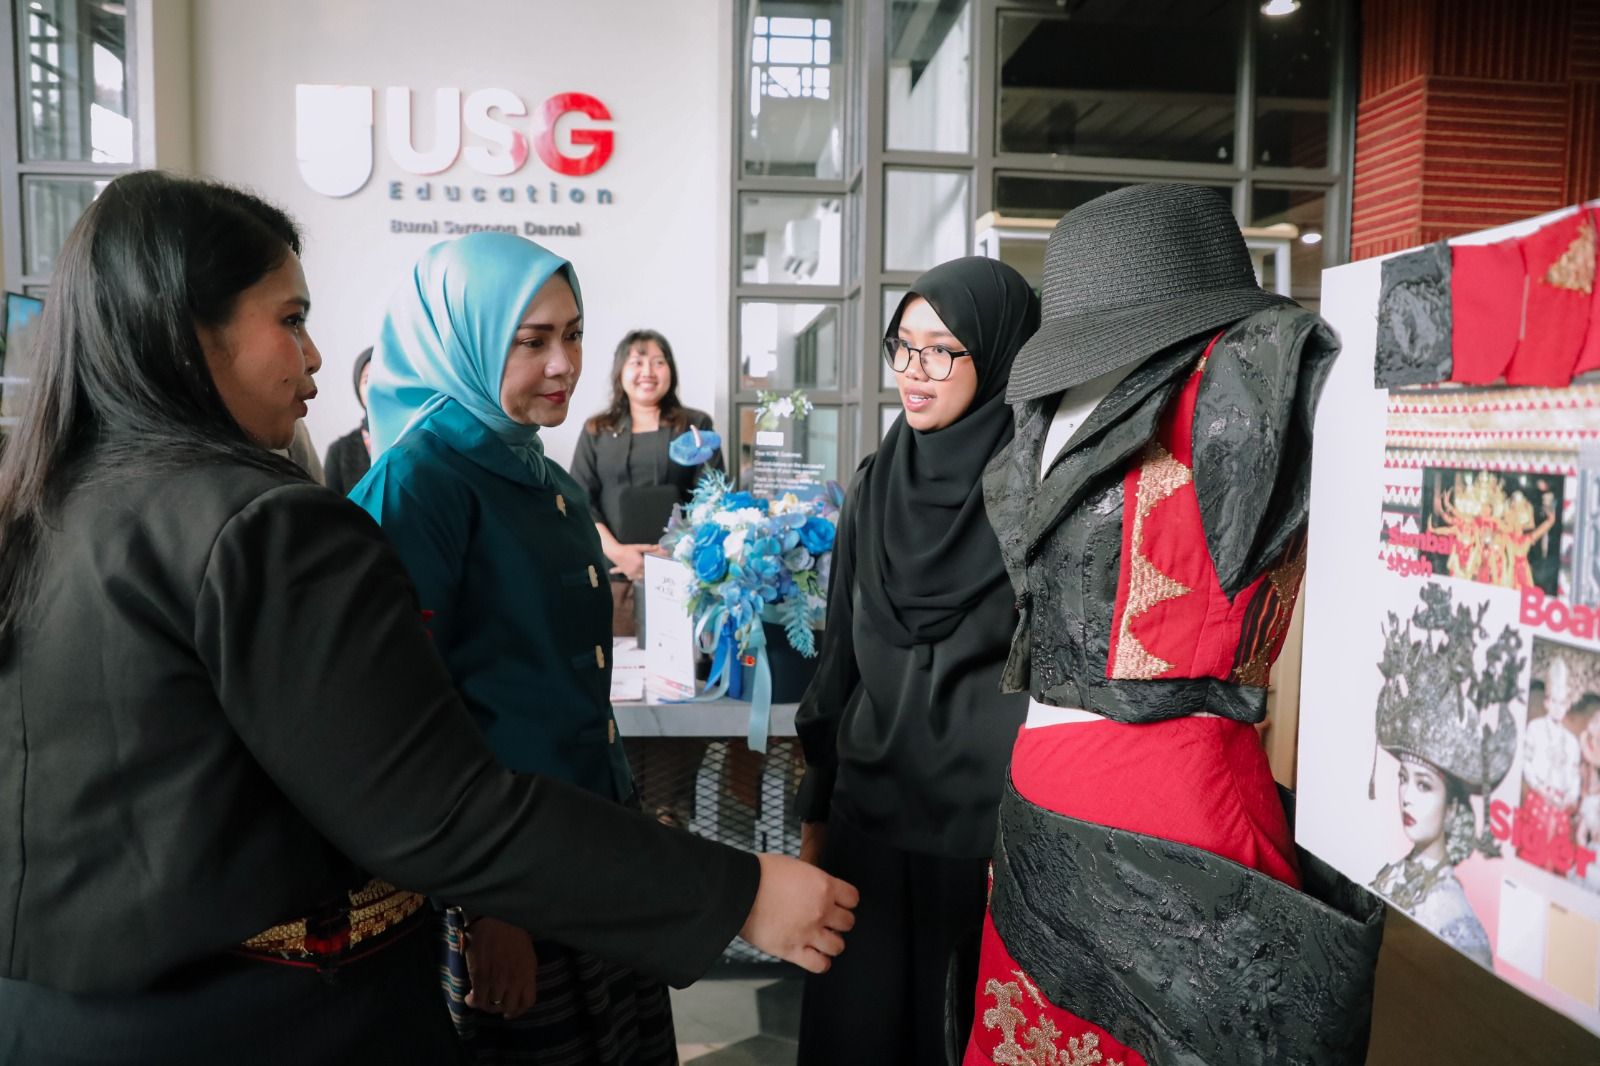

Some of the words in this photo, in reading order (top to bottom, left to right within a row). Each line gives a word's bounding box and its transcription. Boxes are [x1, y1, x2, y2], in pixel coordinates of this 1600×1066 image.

[386, 85, 615, 177] USG
[388, 181, 615, 205] Education
[389, 219, 438, 233] Bumi
[524, 221, 580, 236] Damai
